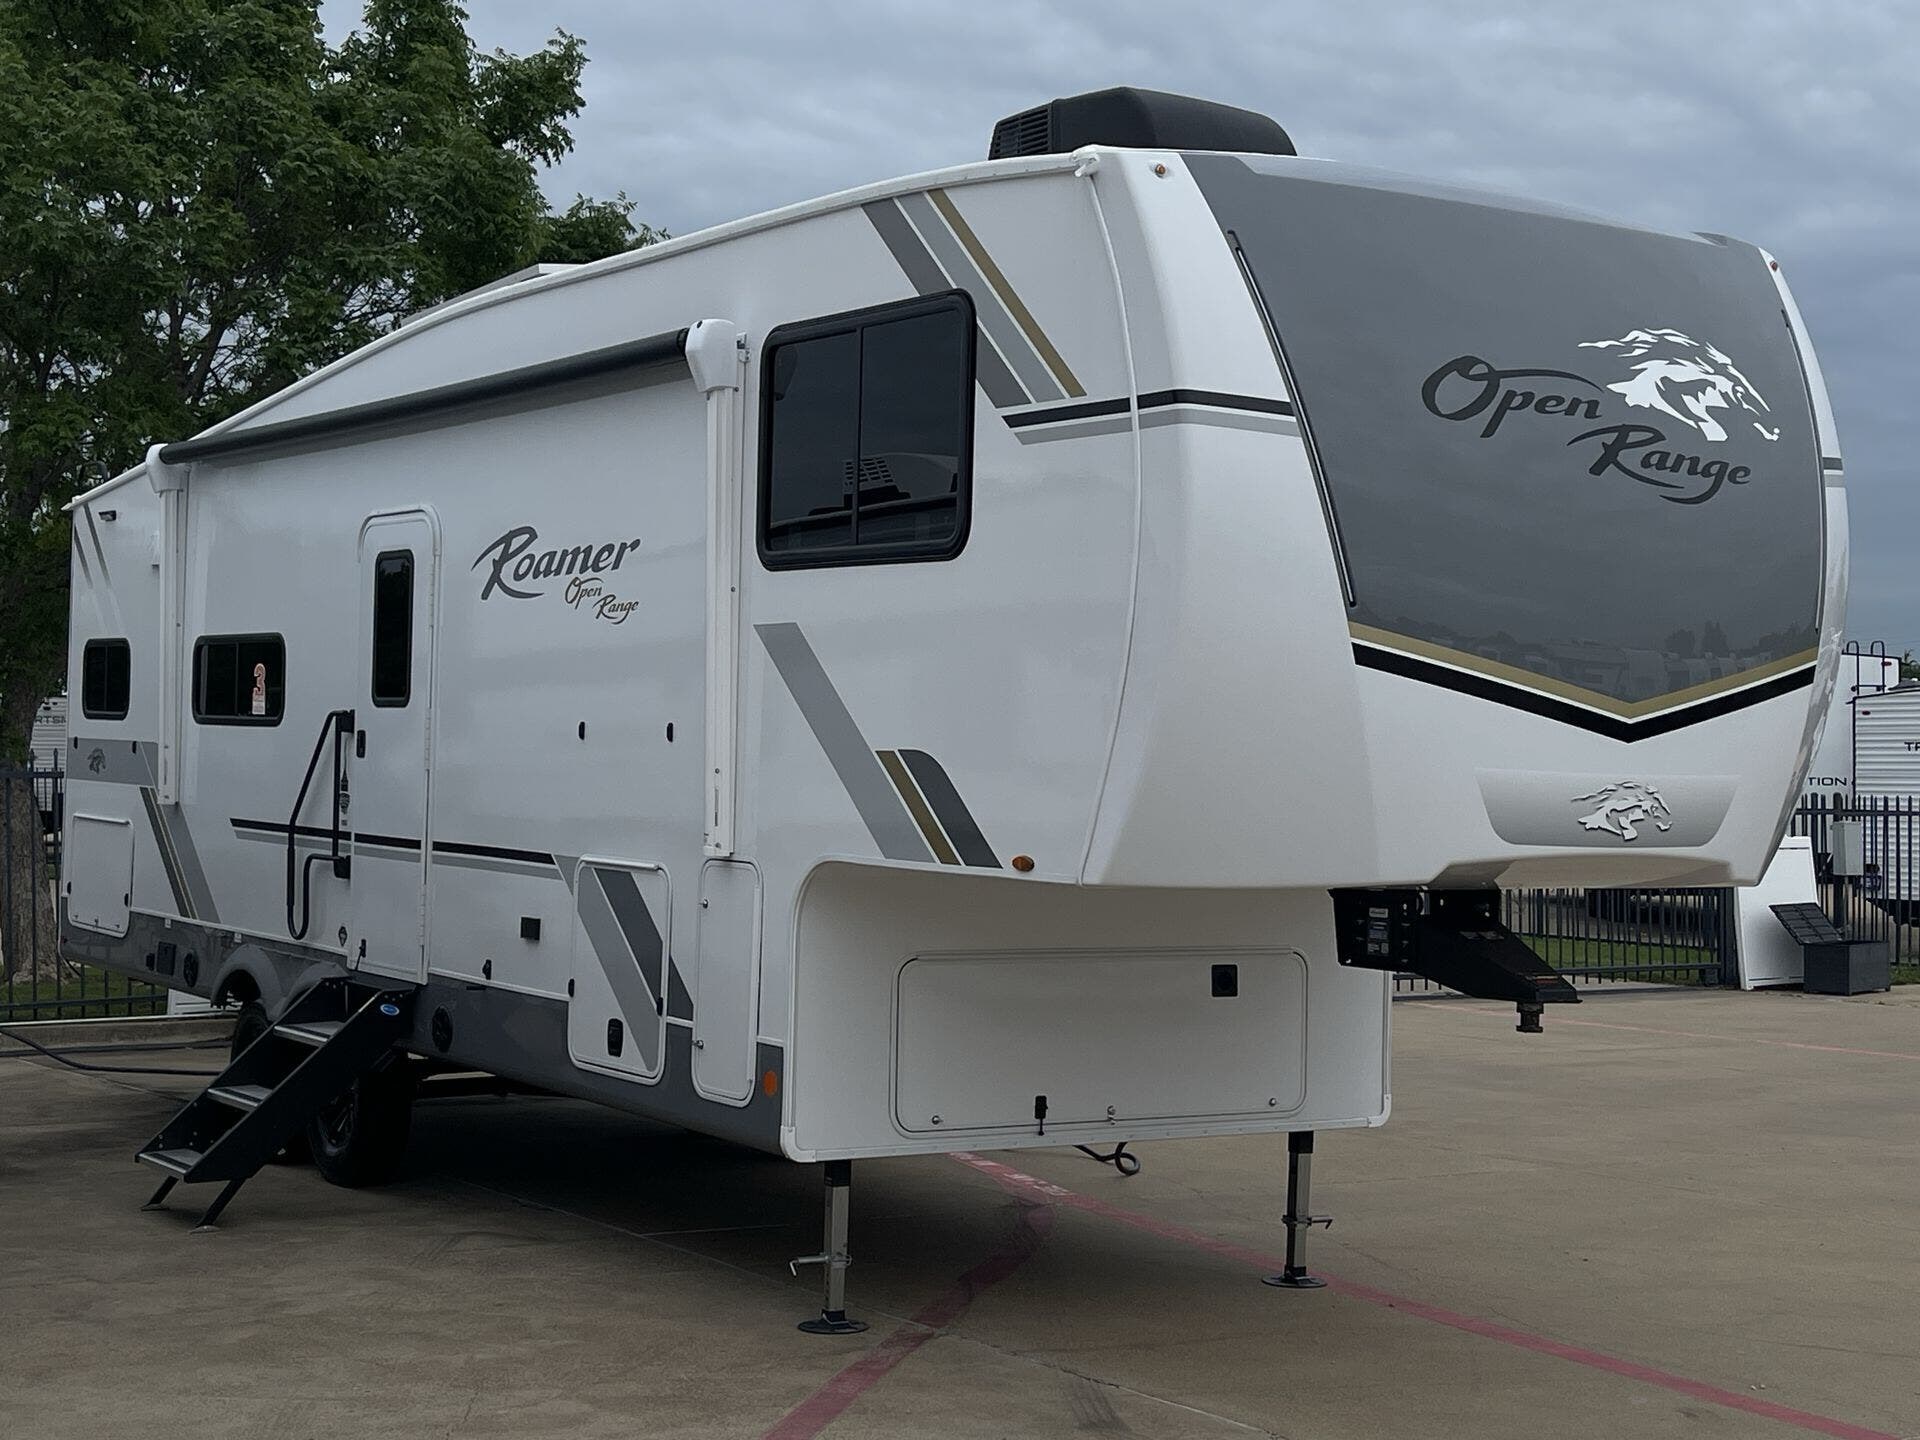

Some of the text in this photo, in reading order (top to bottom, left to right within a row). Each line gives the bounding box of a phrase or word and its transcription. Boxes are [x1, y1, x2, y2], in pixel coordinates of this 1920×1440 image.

[1421, 355, 1605, 438] Open
[1567, 423, 1753, 505] Range
[471, 525, 641, 601] Roamer
[565, 576, 604, 610] Open
[592, 594, 640, 625] Range
[1808, 776, 1847, 786] TION
